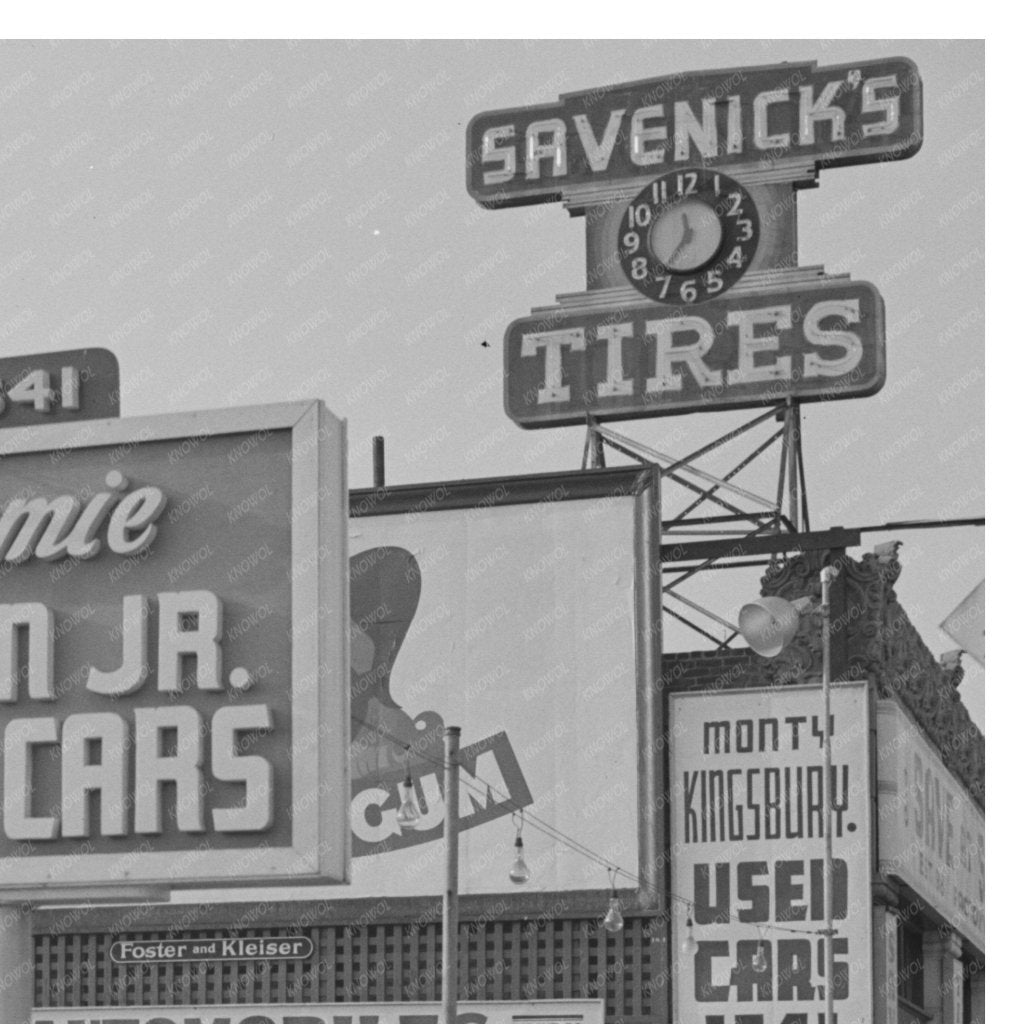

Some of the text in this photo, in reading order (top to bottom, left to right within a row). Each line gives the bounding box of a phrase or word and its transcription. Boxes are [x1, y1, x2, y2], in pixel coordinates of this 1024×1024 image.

[483, 70, 899, 185] SAVENICK'S
[652, 181, 667, 204] 11
[677, 172, 698, 196] 12
[714, 175, 721, 197] 1
[628, 203, 651, 228] 10
[727, 192, 743, 216] 2
[623, 231, 640, 254] 9
[736, 219, 753, 242] 3
[631, 257, 648, 280] 8
[727, 246, 743, 268] 4
[655, 275, 672, 299] 7
[680, 280, 697, 303] 6
[706, 270, 724, 293] 5
[521, 299, 864, 405] TIRES
[86, 590, 257, 696] JR.
[3, 703, 274, 841] CARS
[350, 749, 512, 843] GUM
[693, 858, 848, 925] USED
[120, 939, 303, 959] Foster and Kleiser
[694, 937, 849, 1003] CARS
